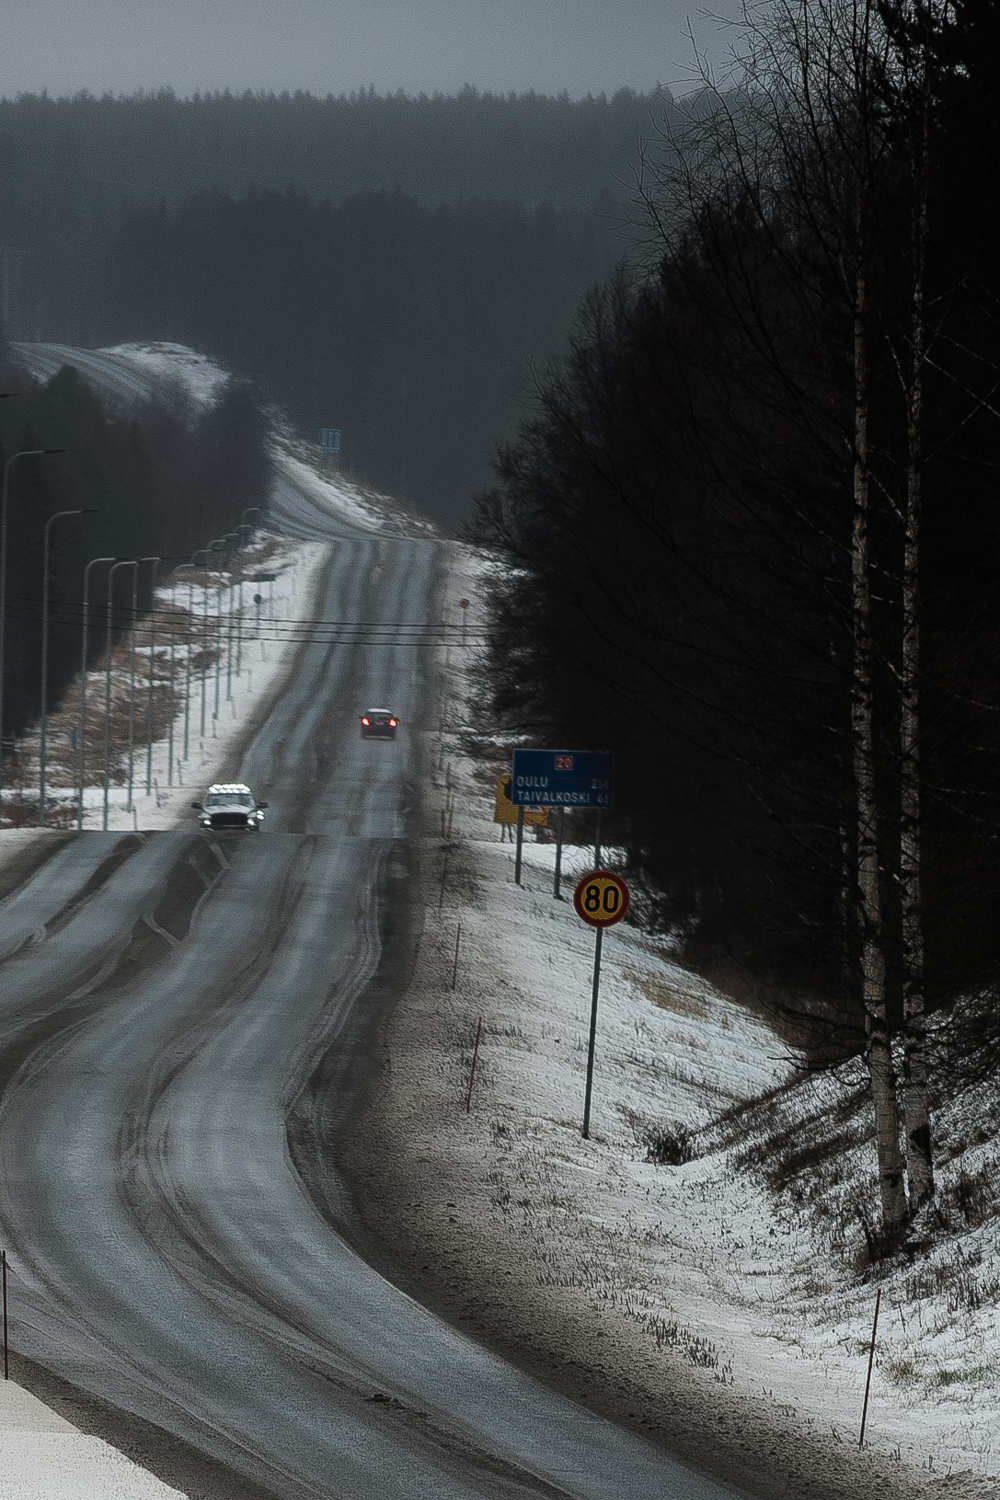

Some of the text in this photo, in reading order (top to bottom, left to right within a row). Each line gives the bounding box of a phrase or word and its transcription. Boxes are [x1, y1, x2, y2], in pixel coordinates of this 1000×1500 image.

[556, 757, 573, 768] 20
[516, 777, 549, 788] OULU
[516, 790, 591, 803] TAIVALKOSKI
[584, 884, 620, 913] 80
